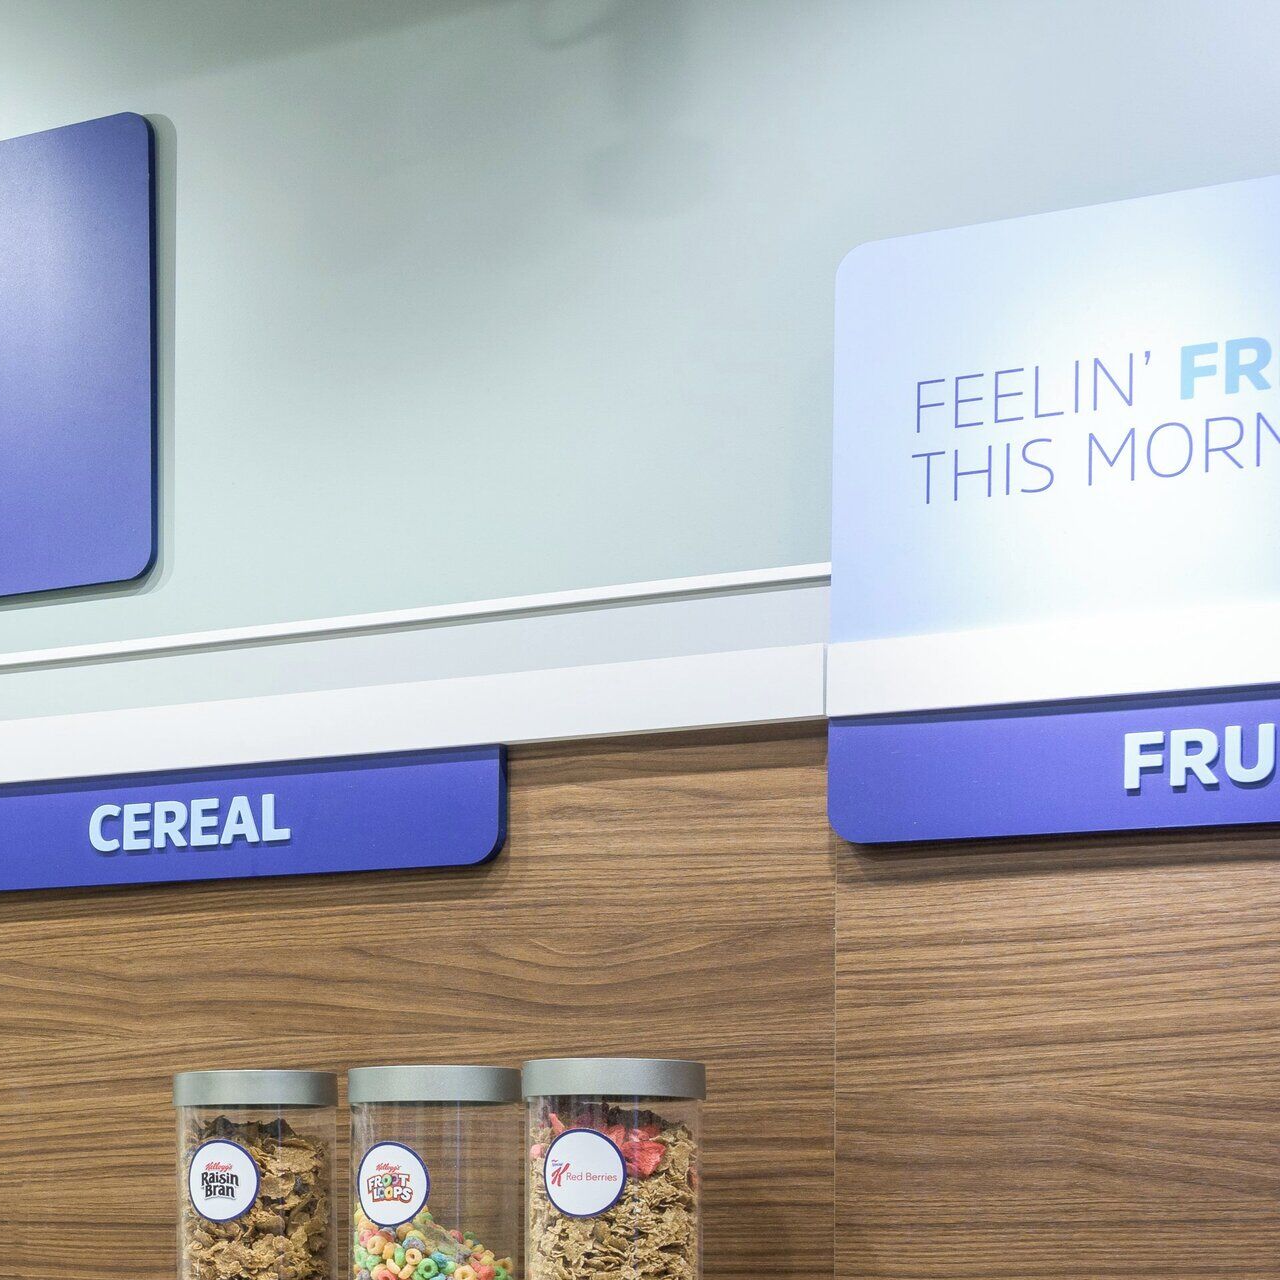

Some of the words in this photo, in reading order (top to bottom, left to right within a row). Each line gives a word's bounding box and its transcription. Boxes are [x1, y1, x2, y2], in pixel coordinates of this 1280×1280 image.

[1179, 336, 1280, 400] FR
[911, 437, 1055, 505] THIS
[1123, 723, 1277, 791] FRU
[89, 793, 291, 852] CEREAL
[201, 1171, 239, 1187] Raisin
[367, 1173, 410, 1194] FROOT
[551, 1162, 570, 1187] K
[566, 1172, 583, 1181] Red
[585, 1172, 618, 1182] Berries
[205, 1185, 235, 1198] Bran
[372, 1186, 413, 1203] LOOPS
